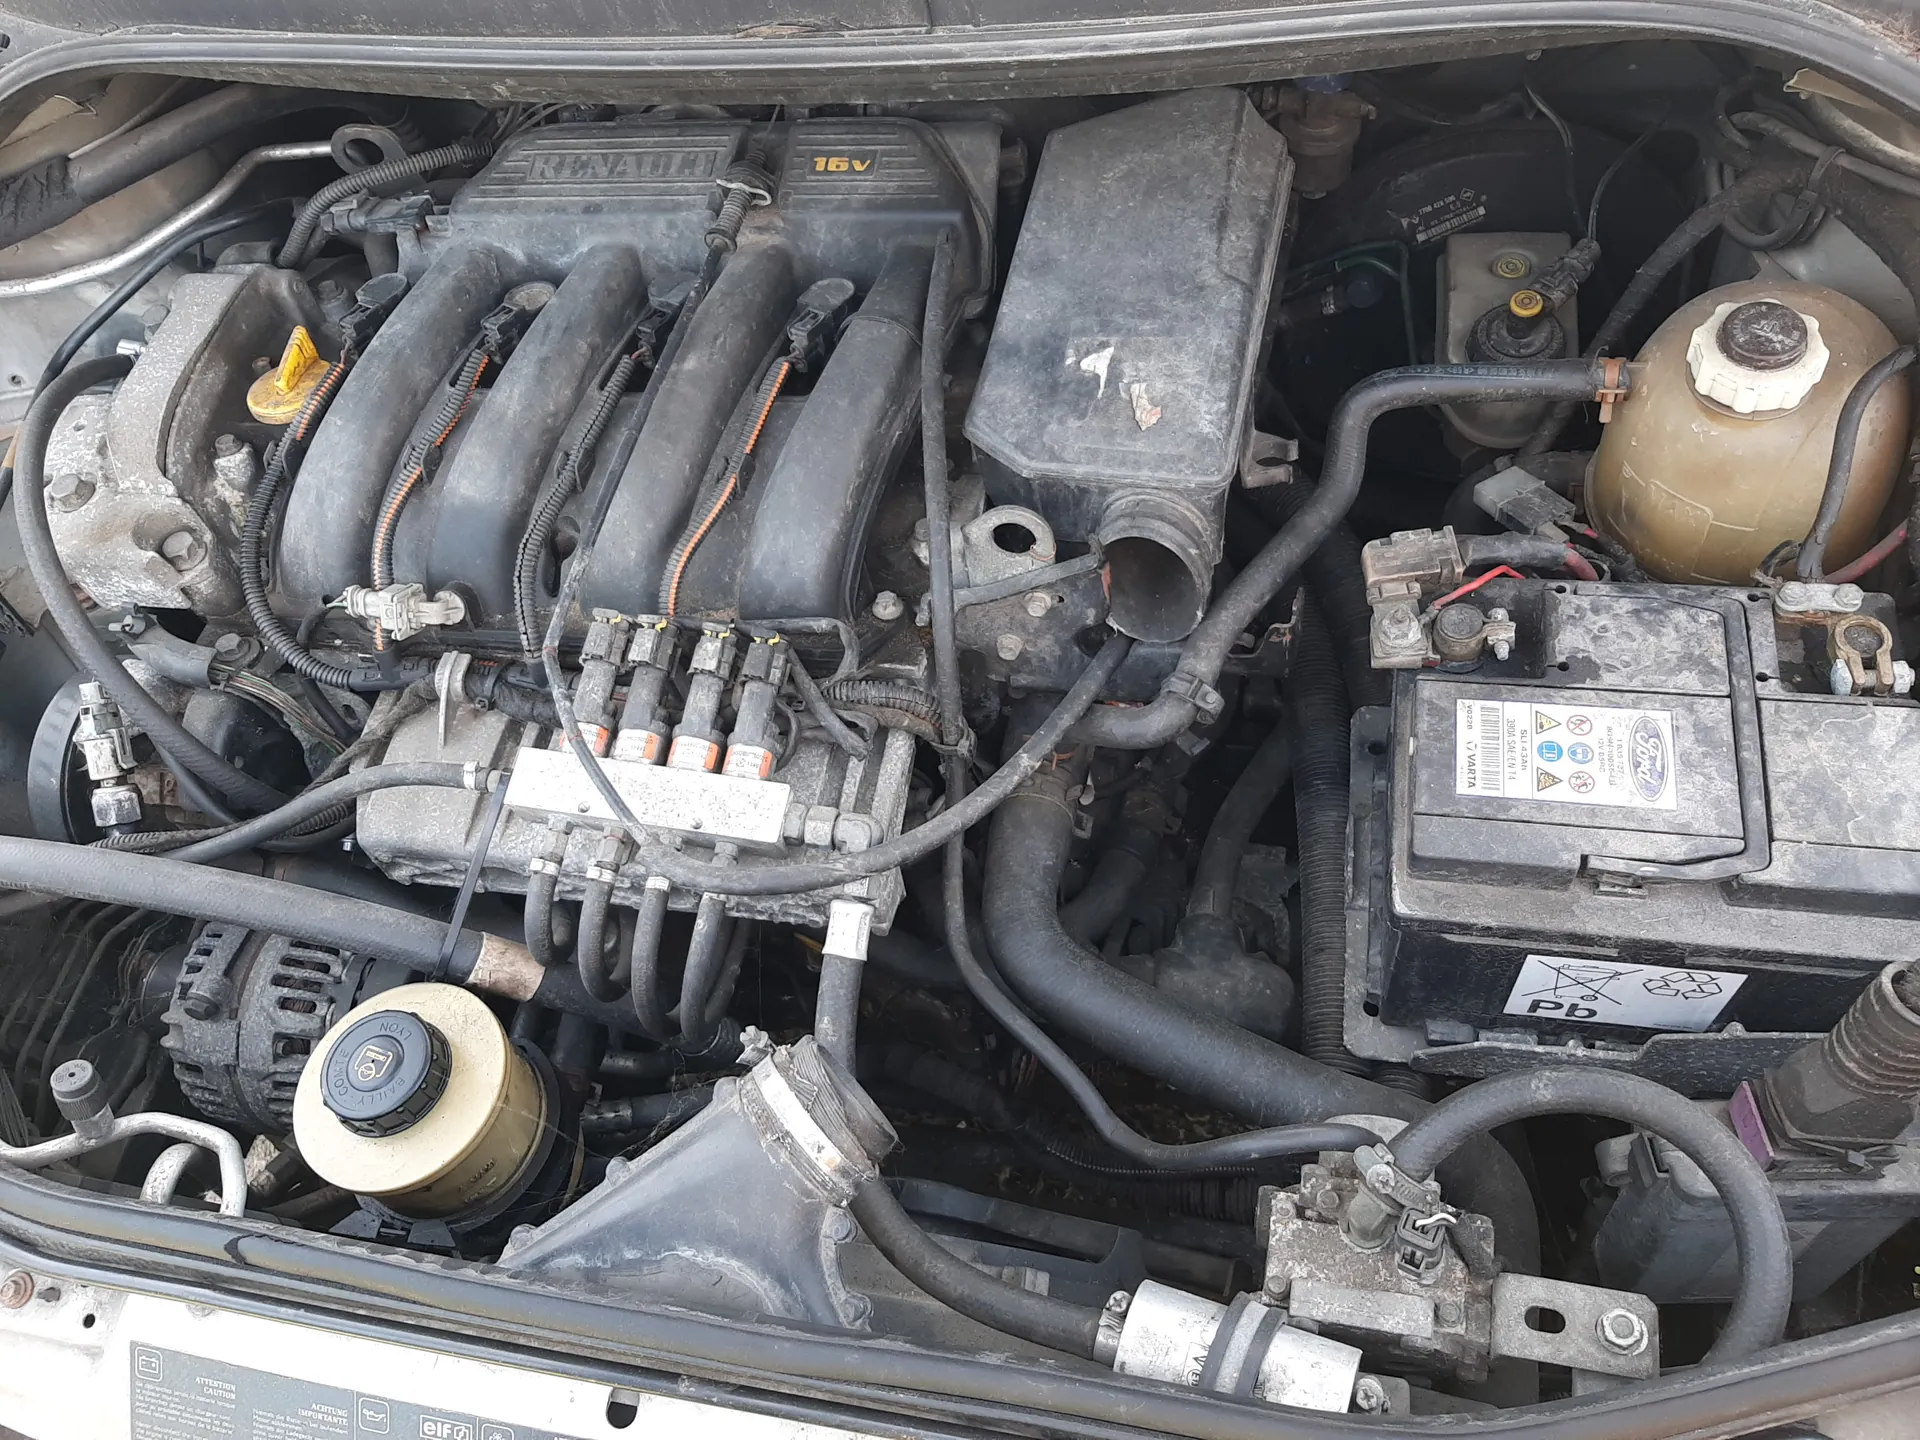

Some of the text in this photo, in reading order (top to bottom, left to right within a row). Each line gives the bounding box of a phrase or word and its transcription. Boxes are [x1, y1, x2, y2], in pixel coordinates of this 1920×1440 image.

[1506, 718, 1516, 738] 390A
[1506, 739, 1517, 769] SAE/EN
[1520, 728, 1528, 771] SLI 43Ah
[1634, 731, 1663, 788] Ford
[1467, 753, 1477, 789] VARTA
[1526, 998, 1598, 1019] Pb
[379, 1021, 413, 1041] LYON
[203, 1386, 236, 1400] CAUTION
[297, 1408, 349, 1426] IMPORTANTE
[310, 1402, 348, 1418] ACHTUNG
[423, 1421, 452, 1438] elf
